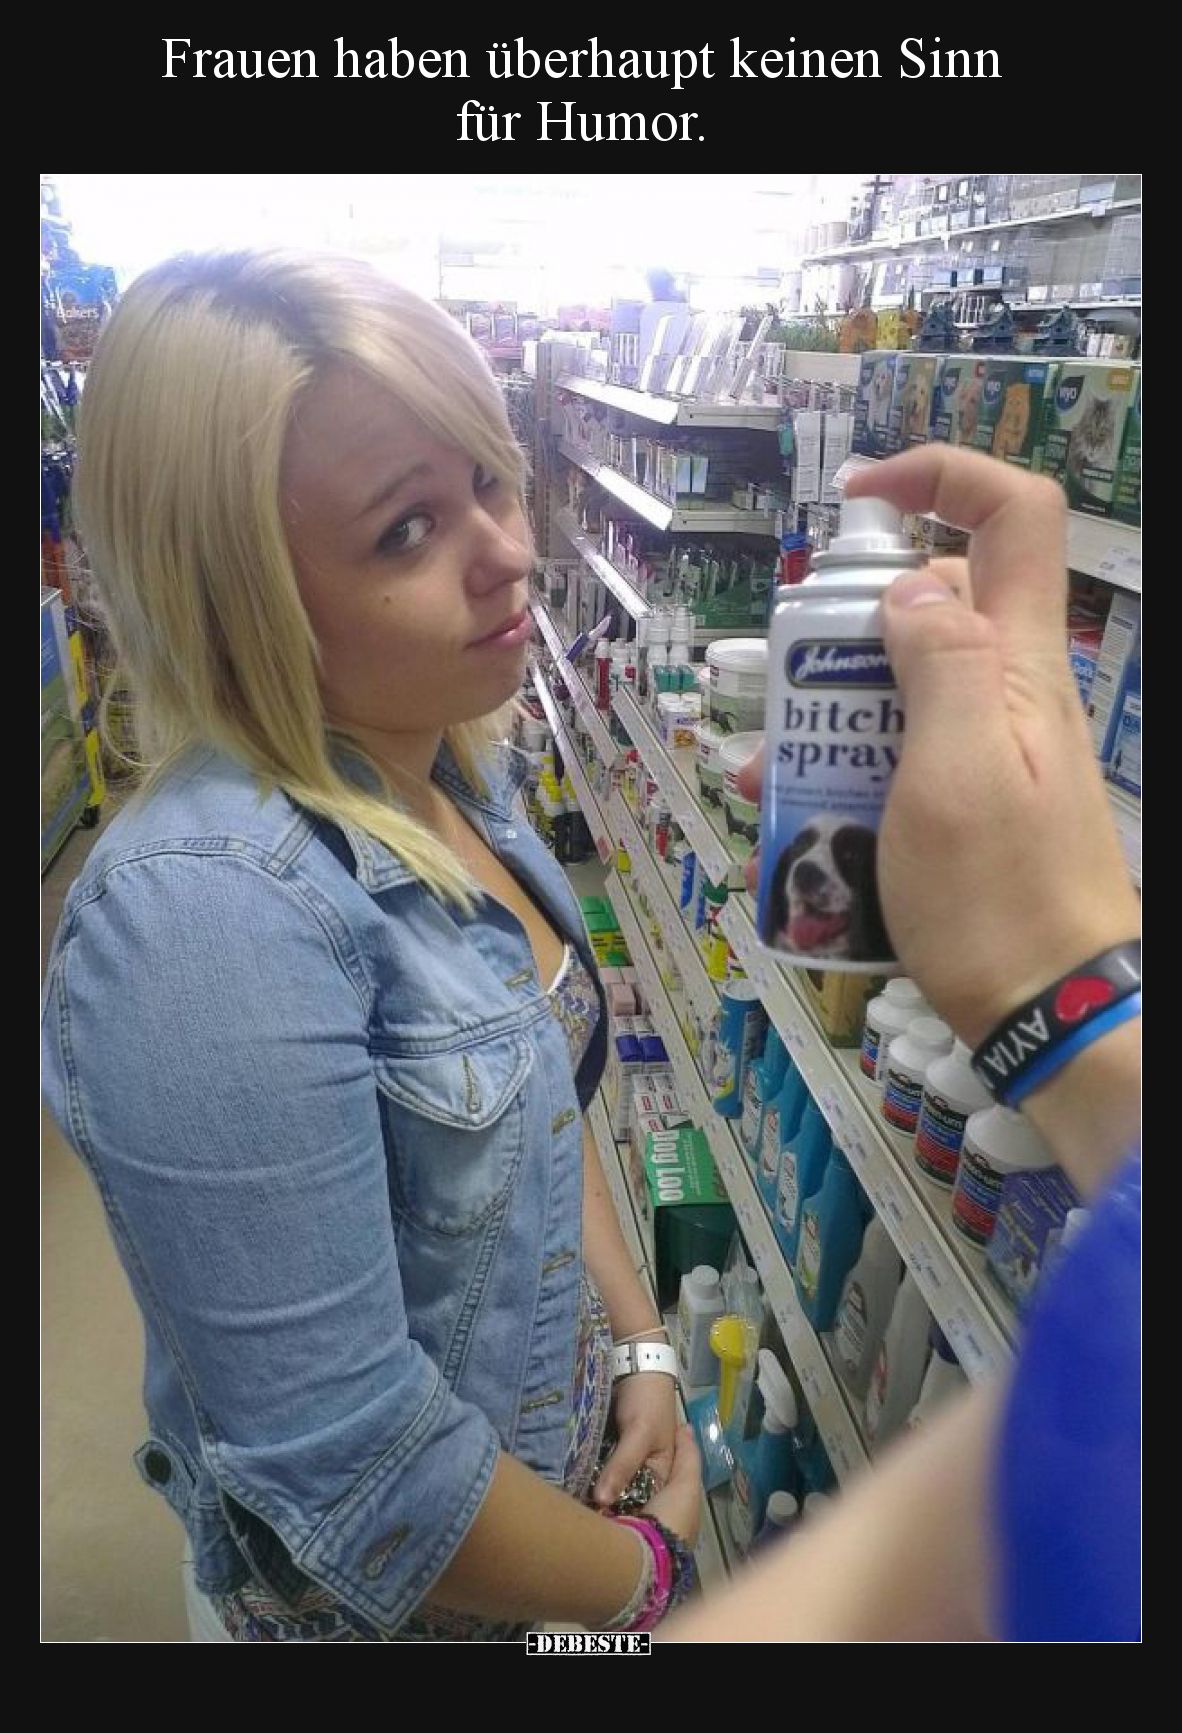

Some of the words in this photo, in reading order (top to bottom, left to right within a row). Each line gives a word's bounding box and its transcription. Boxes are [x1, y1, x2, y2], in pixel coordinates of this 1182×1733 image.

[784, 698, 905, 733] bitch
[777, 741, 899, 782] spray
[983, 1008, 1050, 1077] AYIA
[650, 1130, 680, 1164] Dog
[656, 1168, 684, 1201] Loo
